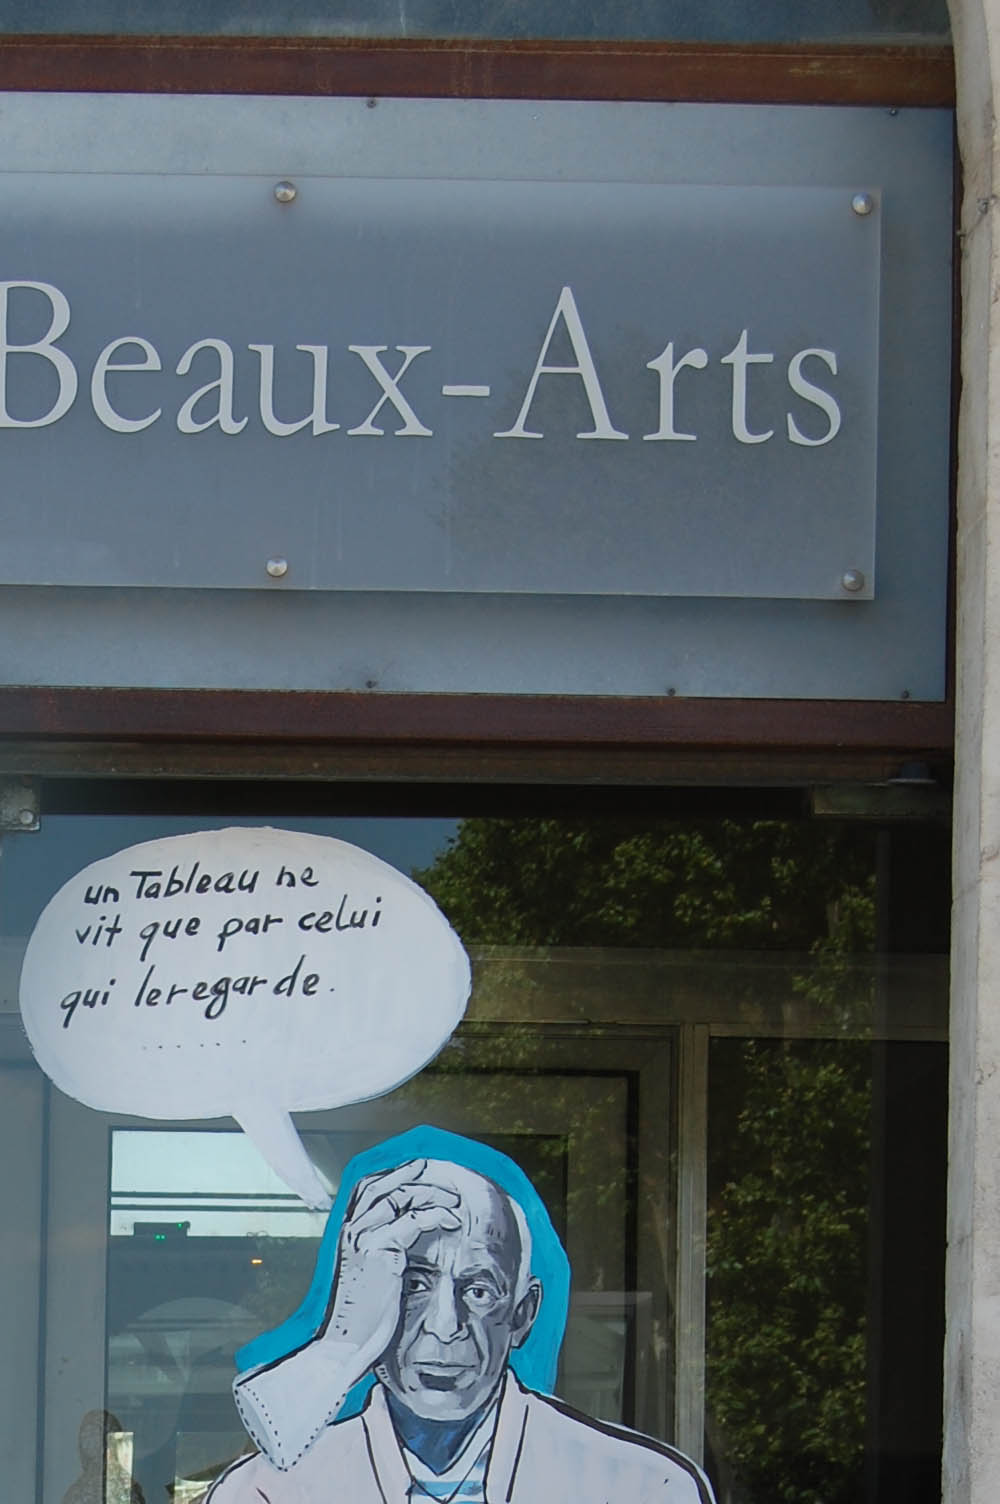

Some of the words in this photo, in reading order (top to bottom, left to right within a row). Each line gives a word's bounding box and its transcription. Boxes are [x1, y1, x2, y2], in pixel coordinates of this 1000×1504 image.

[83, 884, 121, 905] un
[129, 862, 261, 900] Tableau
[275, 865, 320, 889] ne
[75, 914, 123, 947] vit
[139, 917, 202, 963] que
[217, 914, 284, 952] par
[298, 893, 382, 934] celui
[60, 977, 117, 1029] qui
